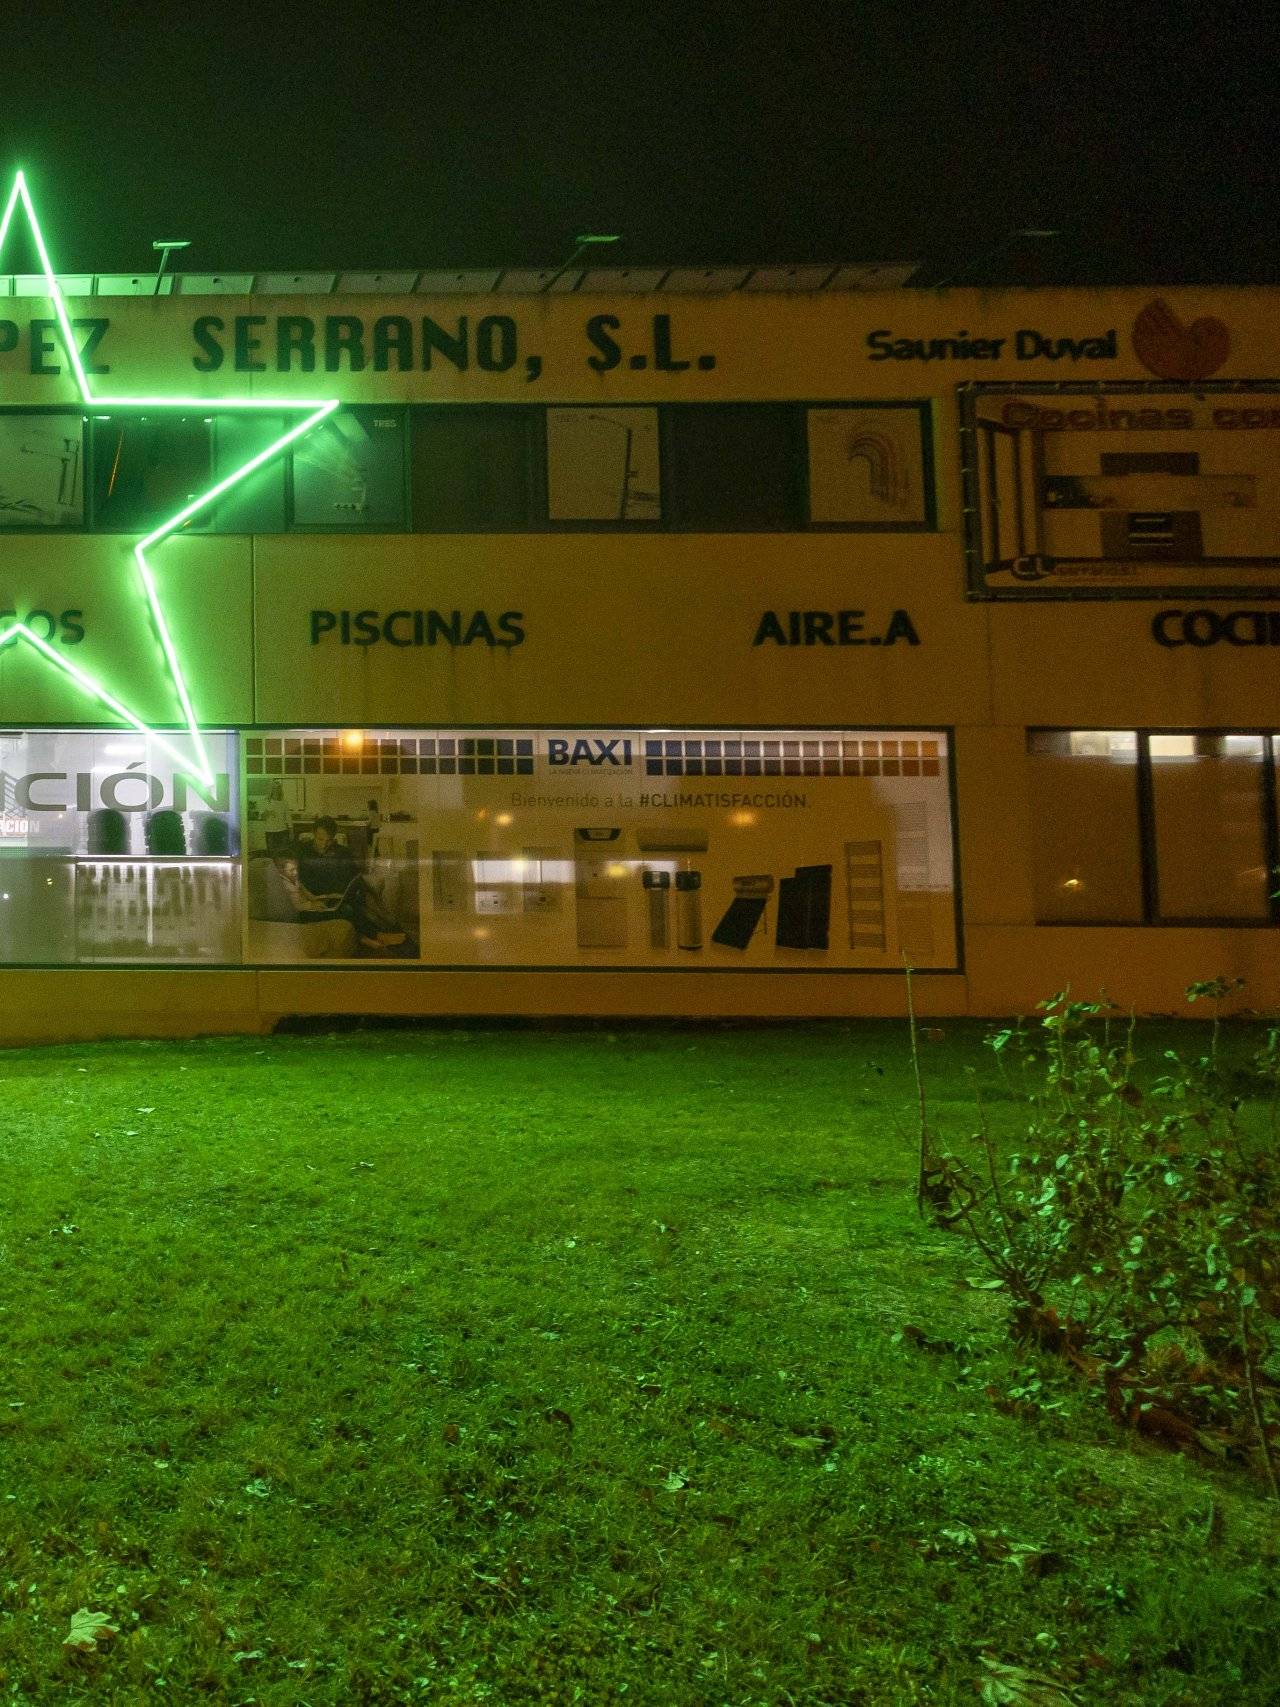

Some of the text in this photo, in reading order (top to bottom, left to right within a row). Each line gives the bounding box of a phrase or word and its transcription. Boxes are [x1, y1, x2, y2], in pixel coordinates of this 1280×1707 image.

[192, 315, 542, 382] SERRANO,
[586, 314, 716, 372] S.L.
[866, 330, 1117, 361] Saunier Duval
[1002, 402, 1194, 430] Cocinas
[310, 609, 525, 647] PISCINAS
[753, 609, 920, 647] AIRE.A
[547, 739, 632, 766] BAXI
[511, 792, 598, 808] Bienvenido
[604, 795, 613, 808] a
[620, 793, 633, 808] la
